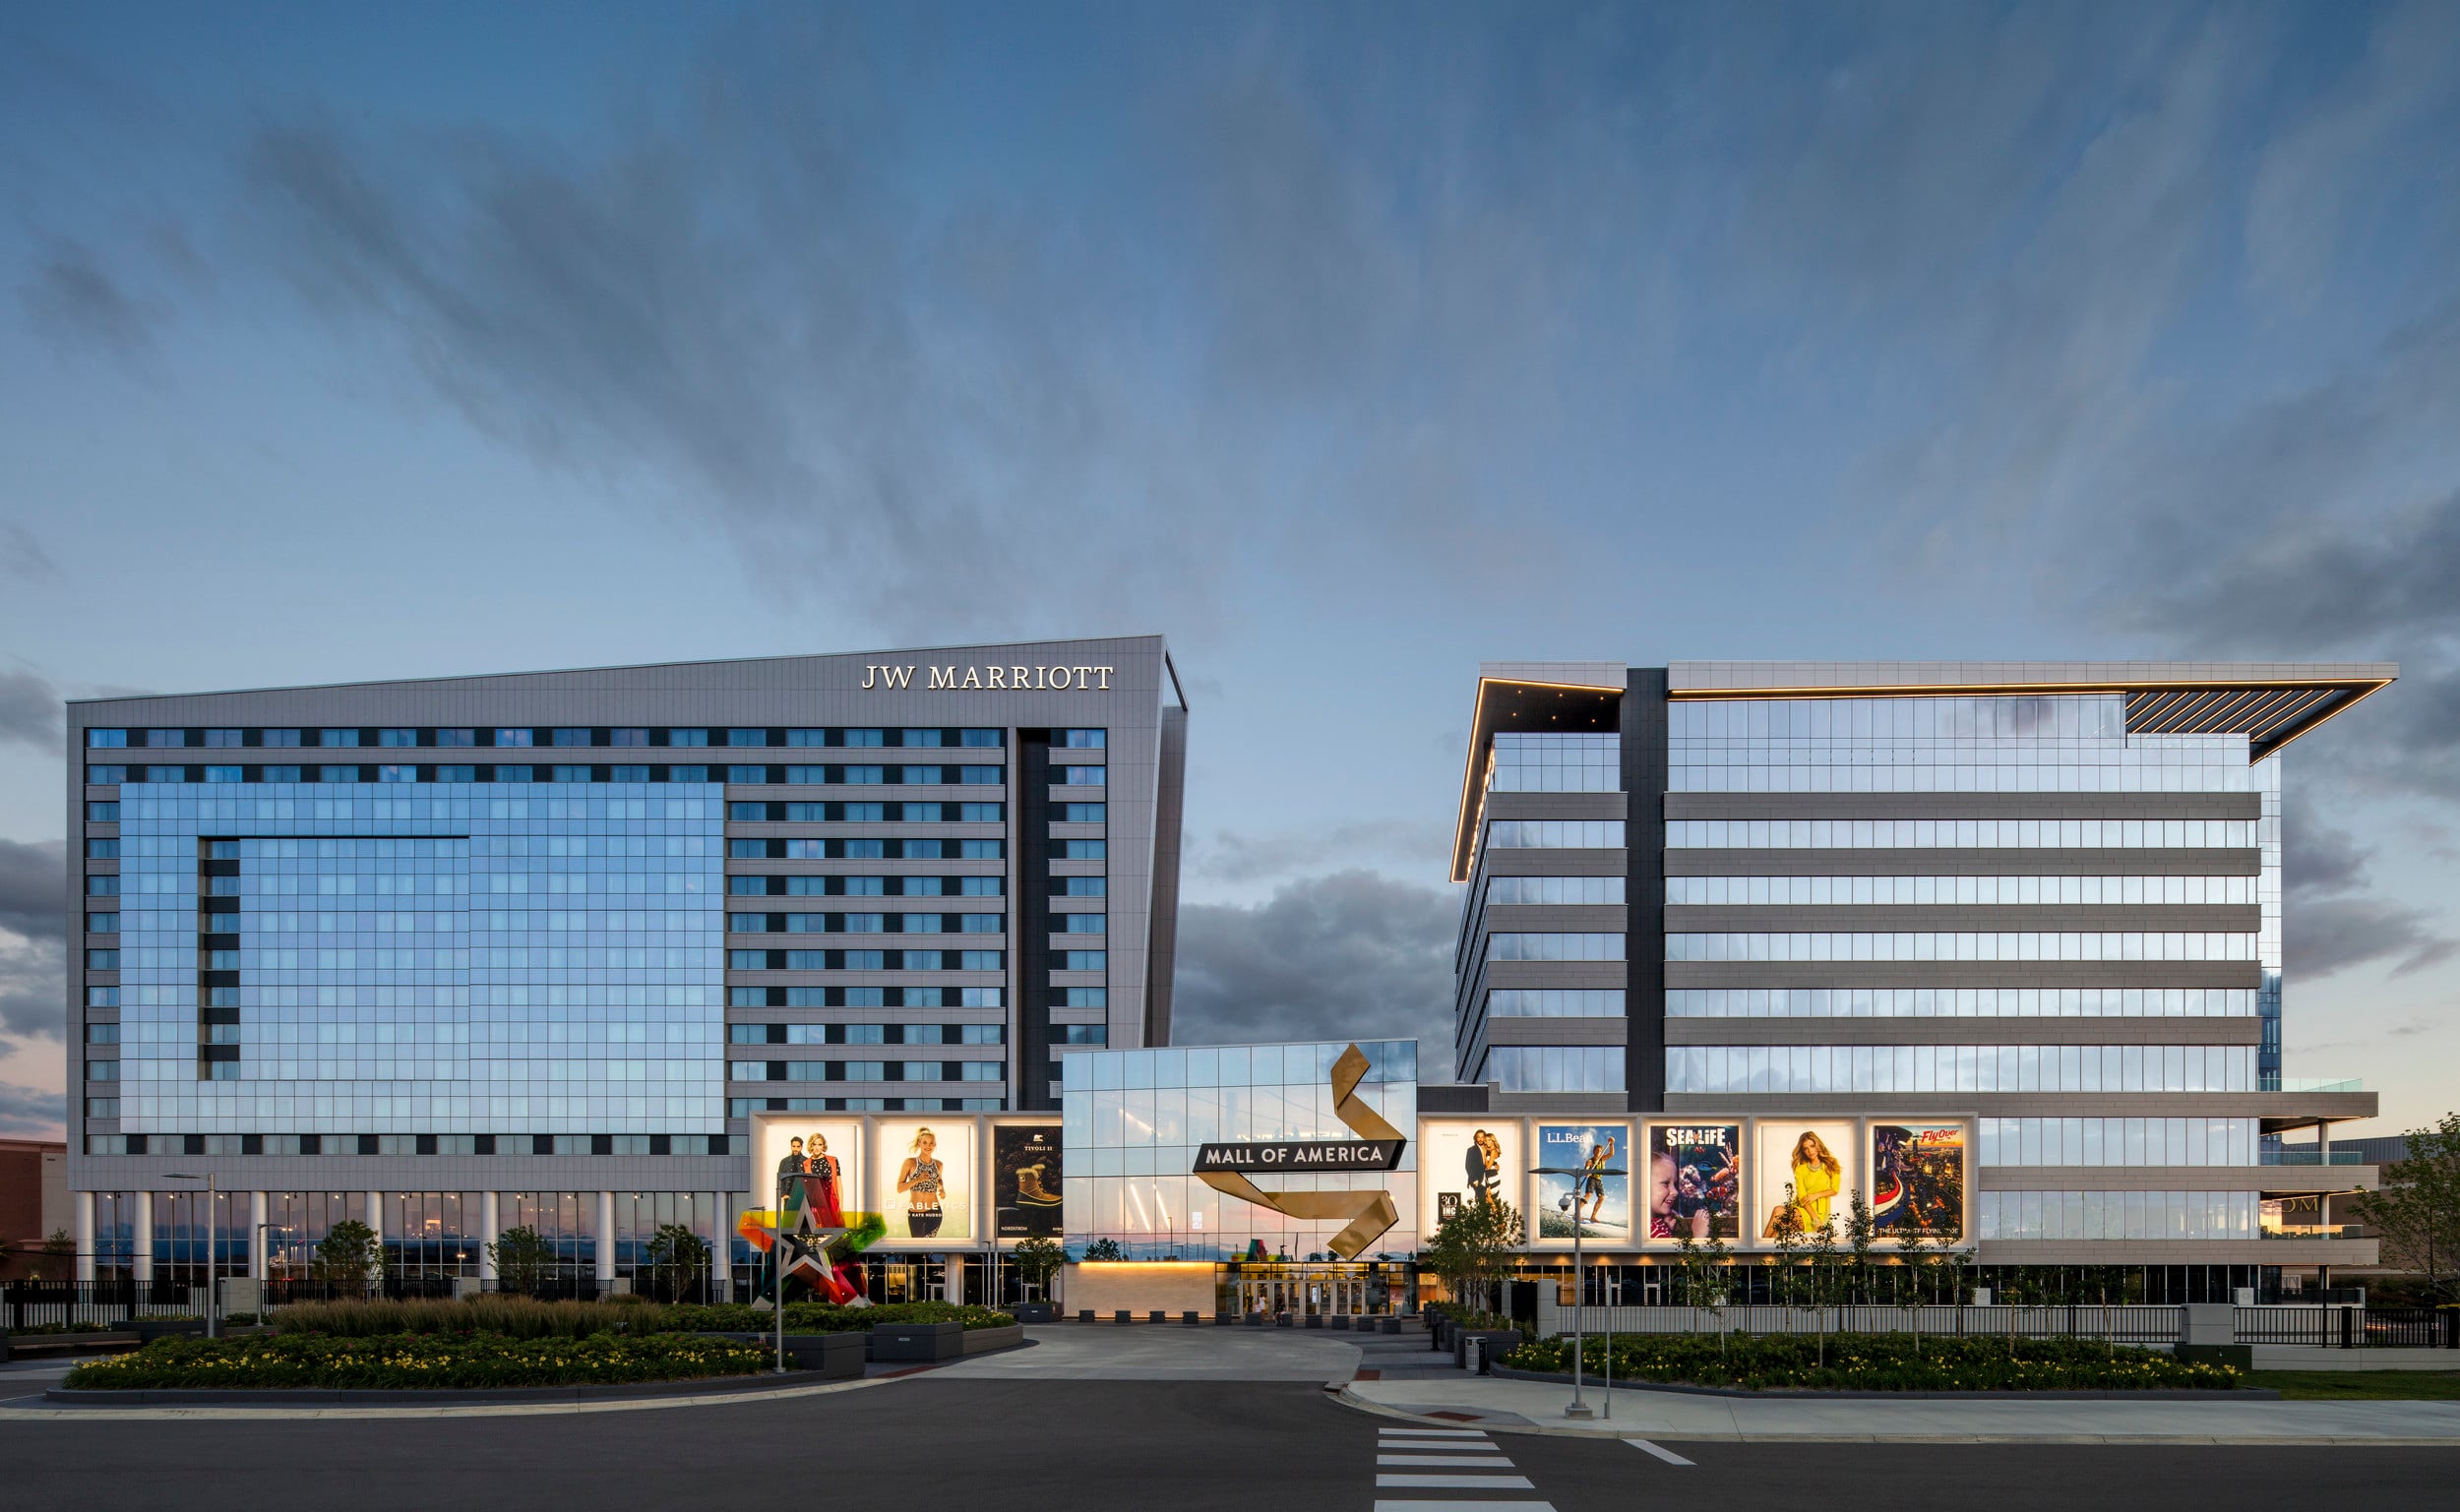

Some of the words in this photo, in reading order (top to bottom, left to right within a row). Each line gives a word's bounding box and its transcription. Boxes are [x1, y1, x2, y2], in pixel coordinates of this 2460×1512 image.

[862, 665, 916, 690] JW
[928, 665, 1114, 690] MARRIOTT
[1666, 1127, 1695, 1147] SEA
[1205, 1148, 1255, 1165] MALL
[1261, 1148, 1288, 1163] OF
[1293, 1146, 1384, 1163] AMERICA
[1441, 1195, 1457, 1207] 30
[1443, 1206, 1456, 1215] INC
